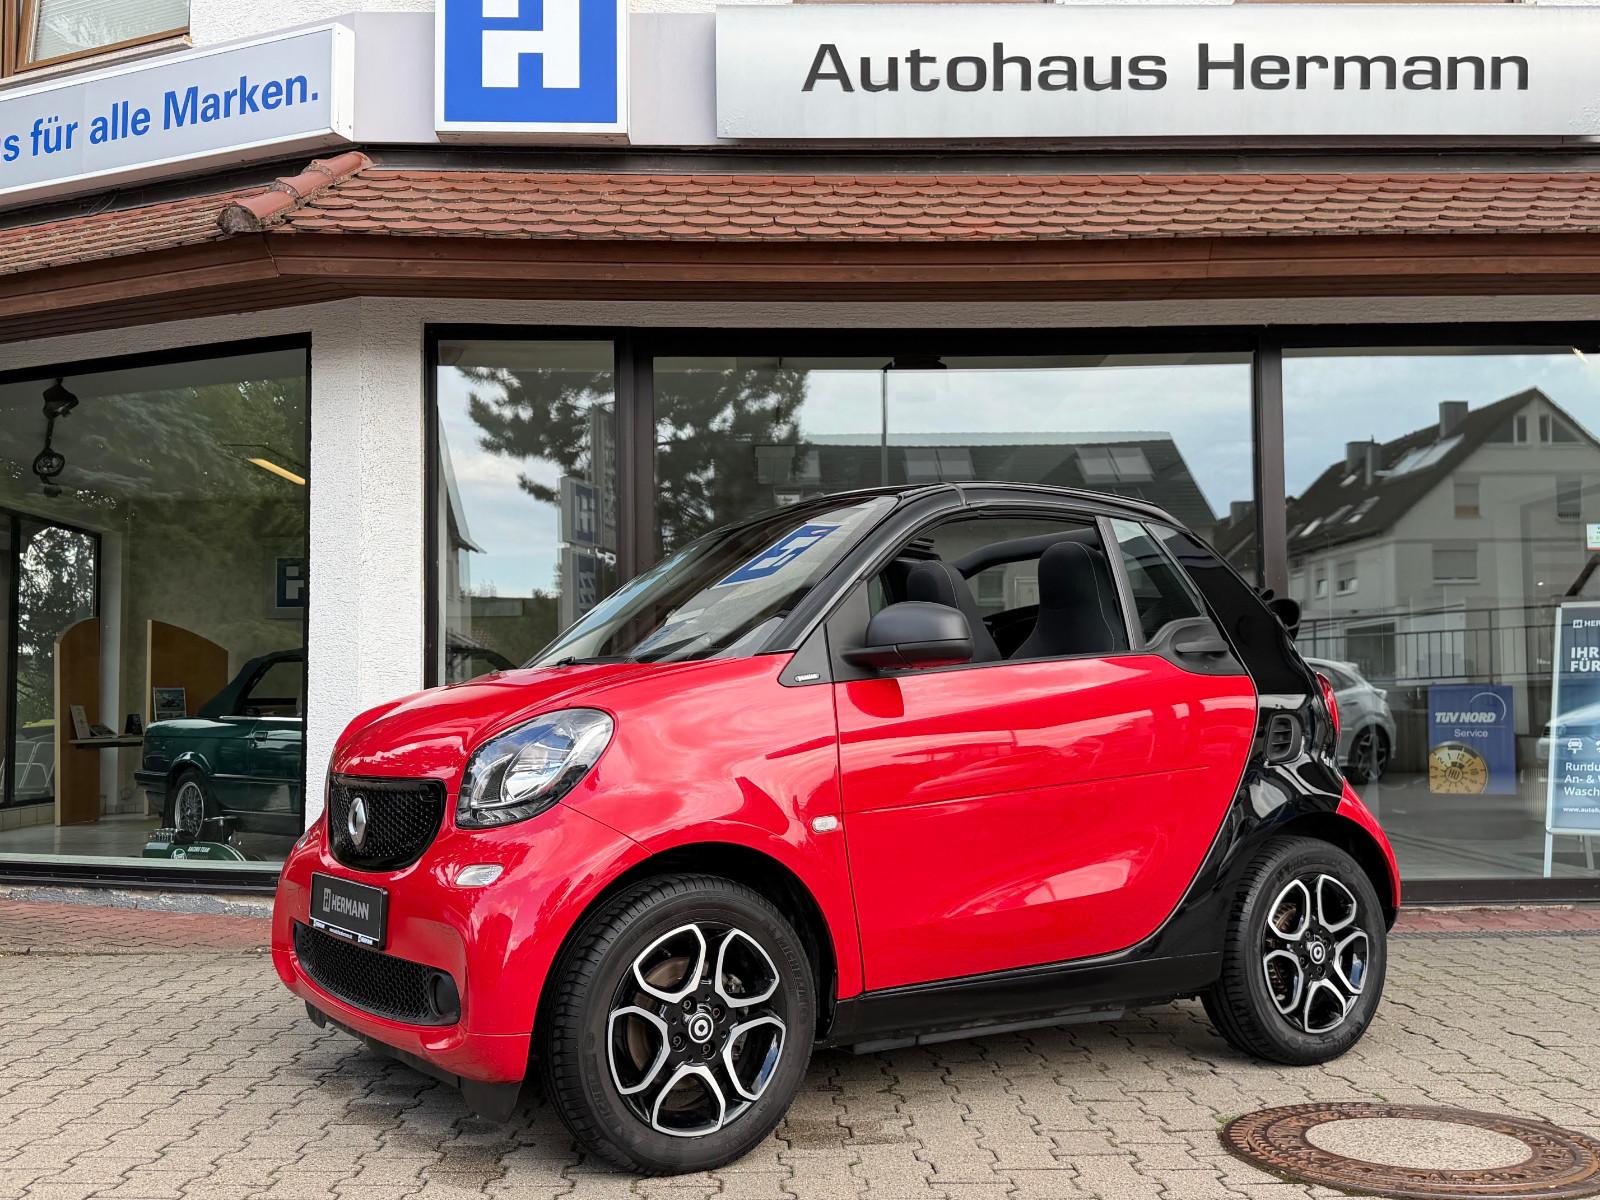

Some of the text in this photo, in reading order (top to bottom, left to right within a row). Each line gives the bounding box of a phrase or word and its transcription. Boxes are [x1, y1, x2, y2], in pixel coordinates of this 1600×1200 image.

[801, 43, 1528, 92] Autohaus Hermann
[30, 115, 78, 156] für
[89, 100, 151, 145] alle
[163, 73, 320, 131] Marken.
[1571, 647, 1599, 658] IHR
[1570, 658, 1600, 672] FÜR
[1459, 711, 1496, 723] NORD
[1454, 729, 1488, 738] Service
[1564, 774, 1583, 784] An-
[1586, 774, 1595, 784] &
[331, 893, 370, 921] HERMANN
